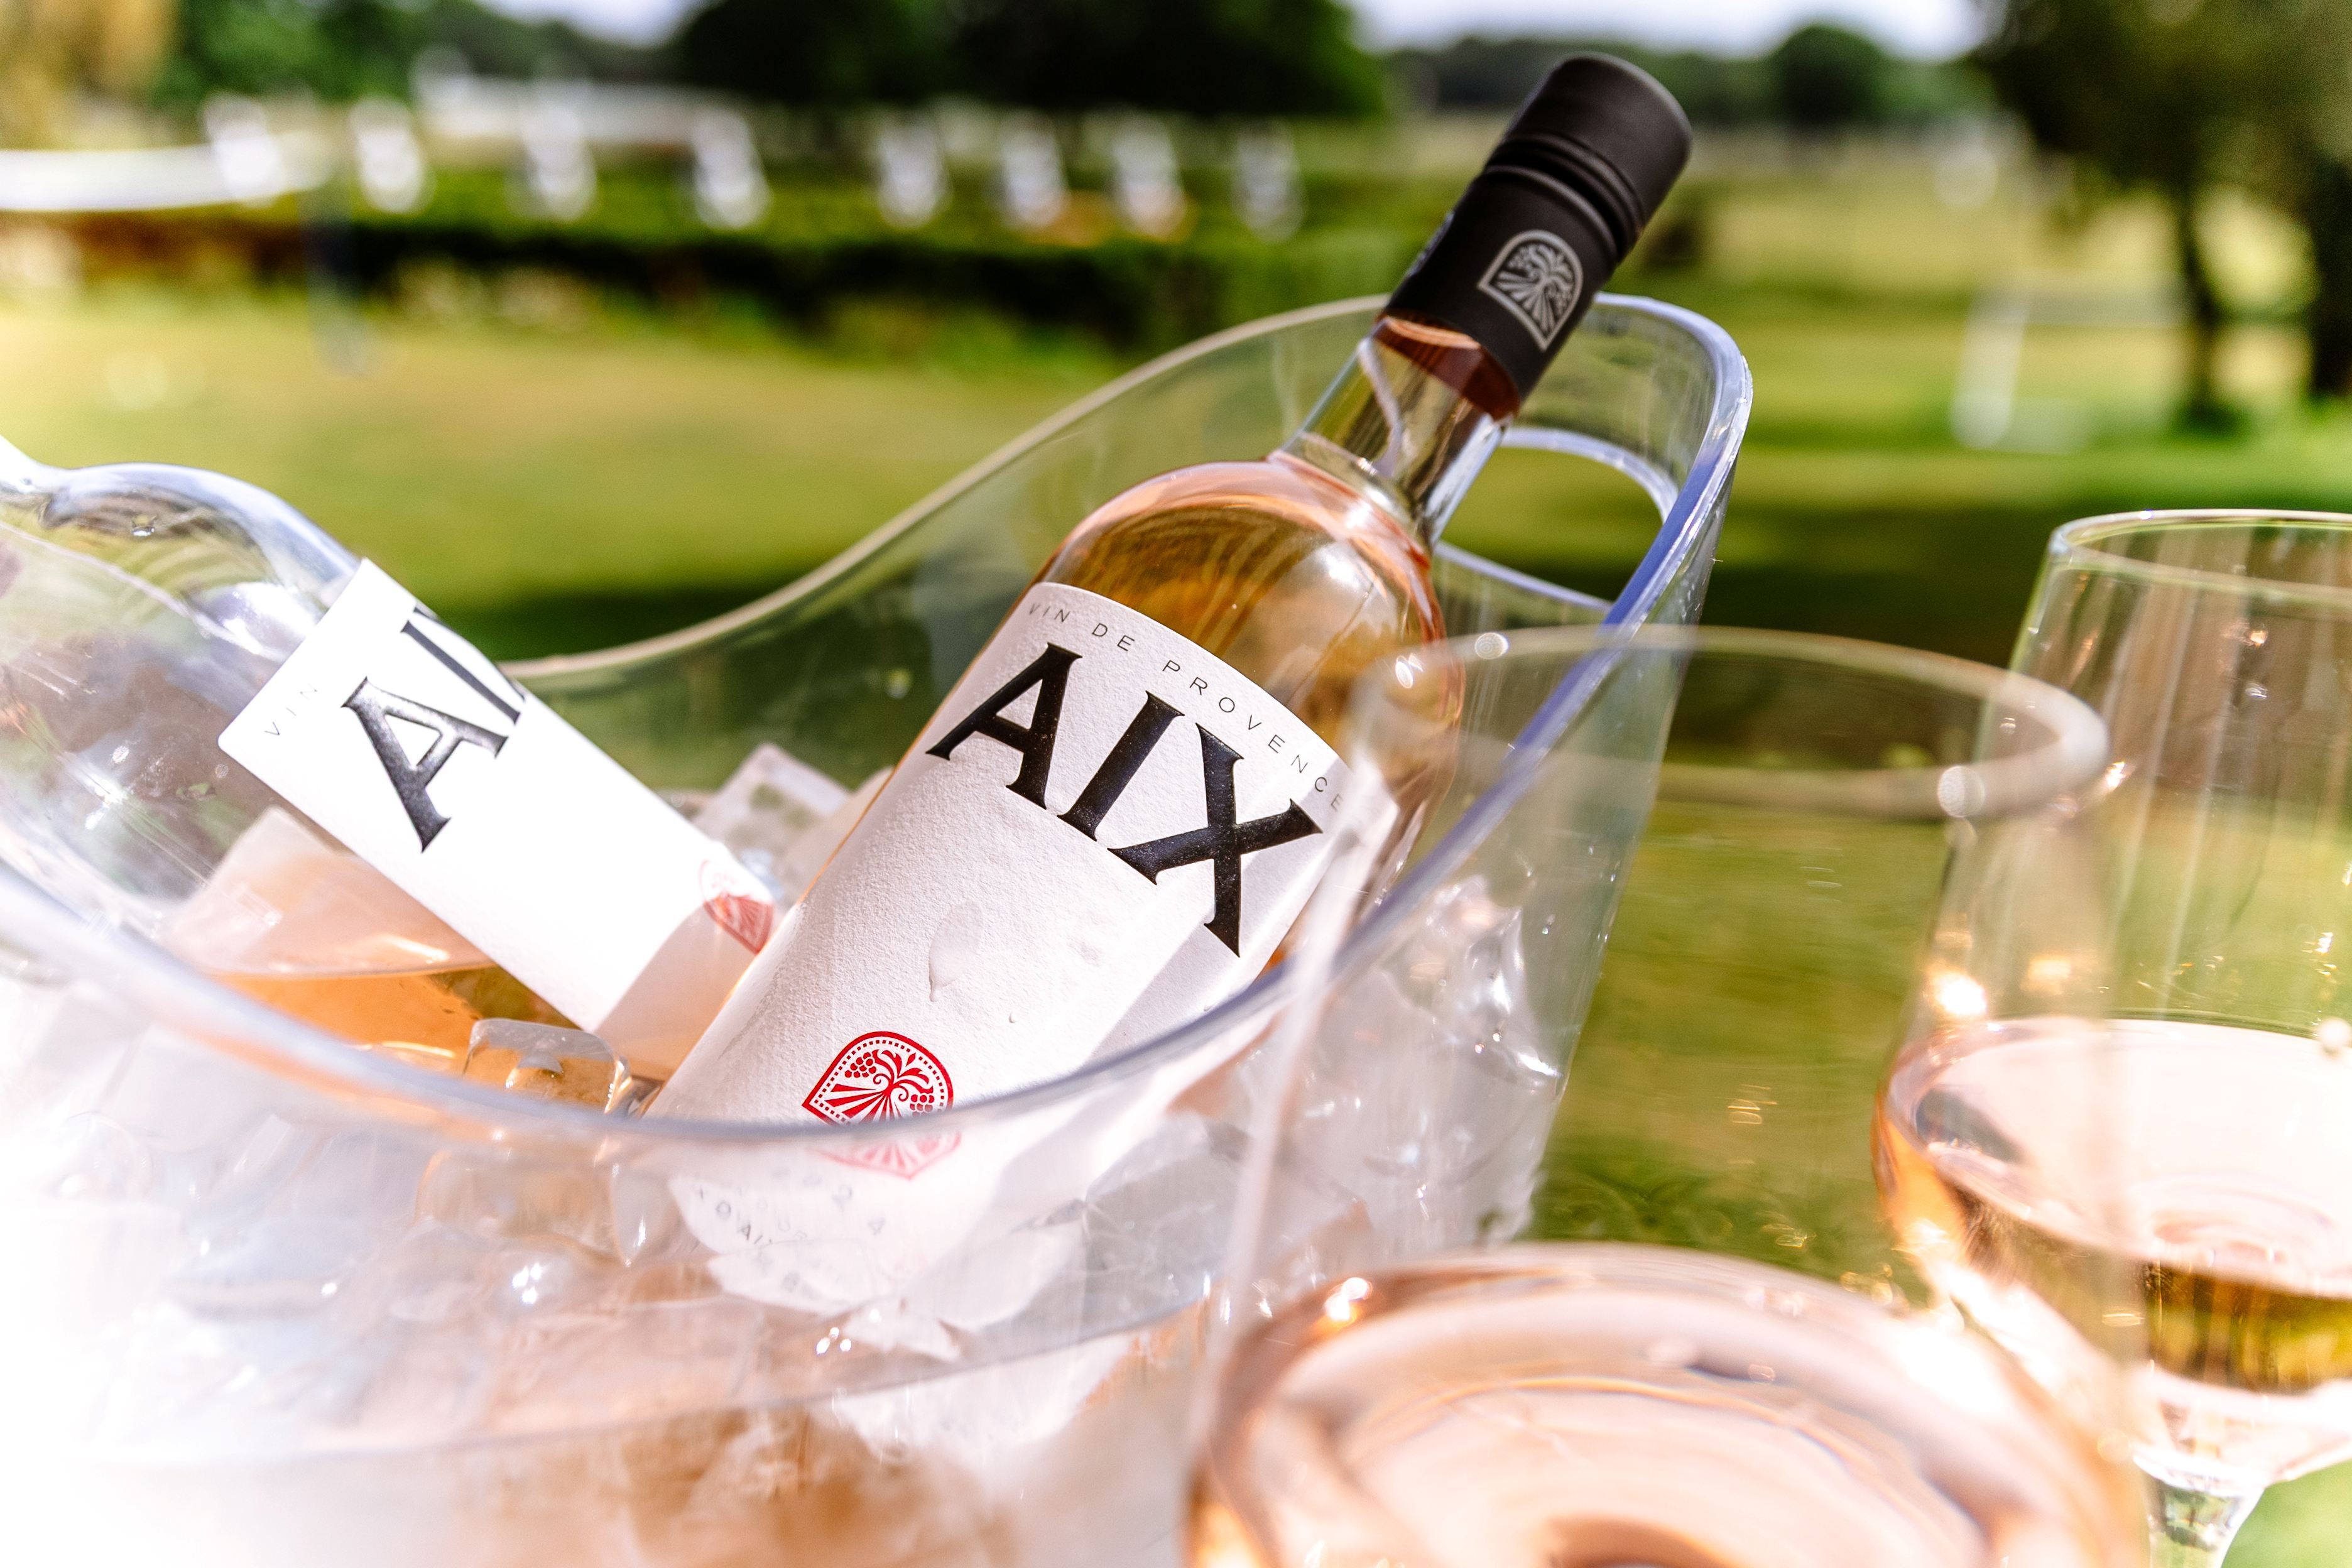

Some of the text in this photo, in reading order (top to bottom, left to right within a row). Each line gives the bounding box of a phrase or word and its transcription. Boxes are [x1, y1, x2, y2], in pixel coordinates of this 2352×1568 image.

[340, 606, 526, 853] AI
[925, 642, 1324, 957] AIX
[1029, 603, 1343, 812] VIN DE PROVENCE
